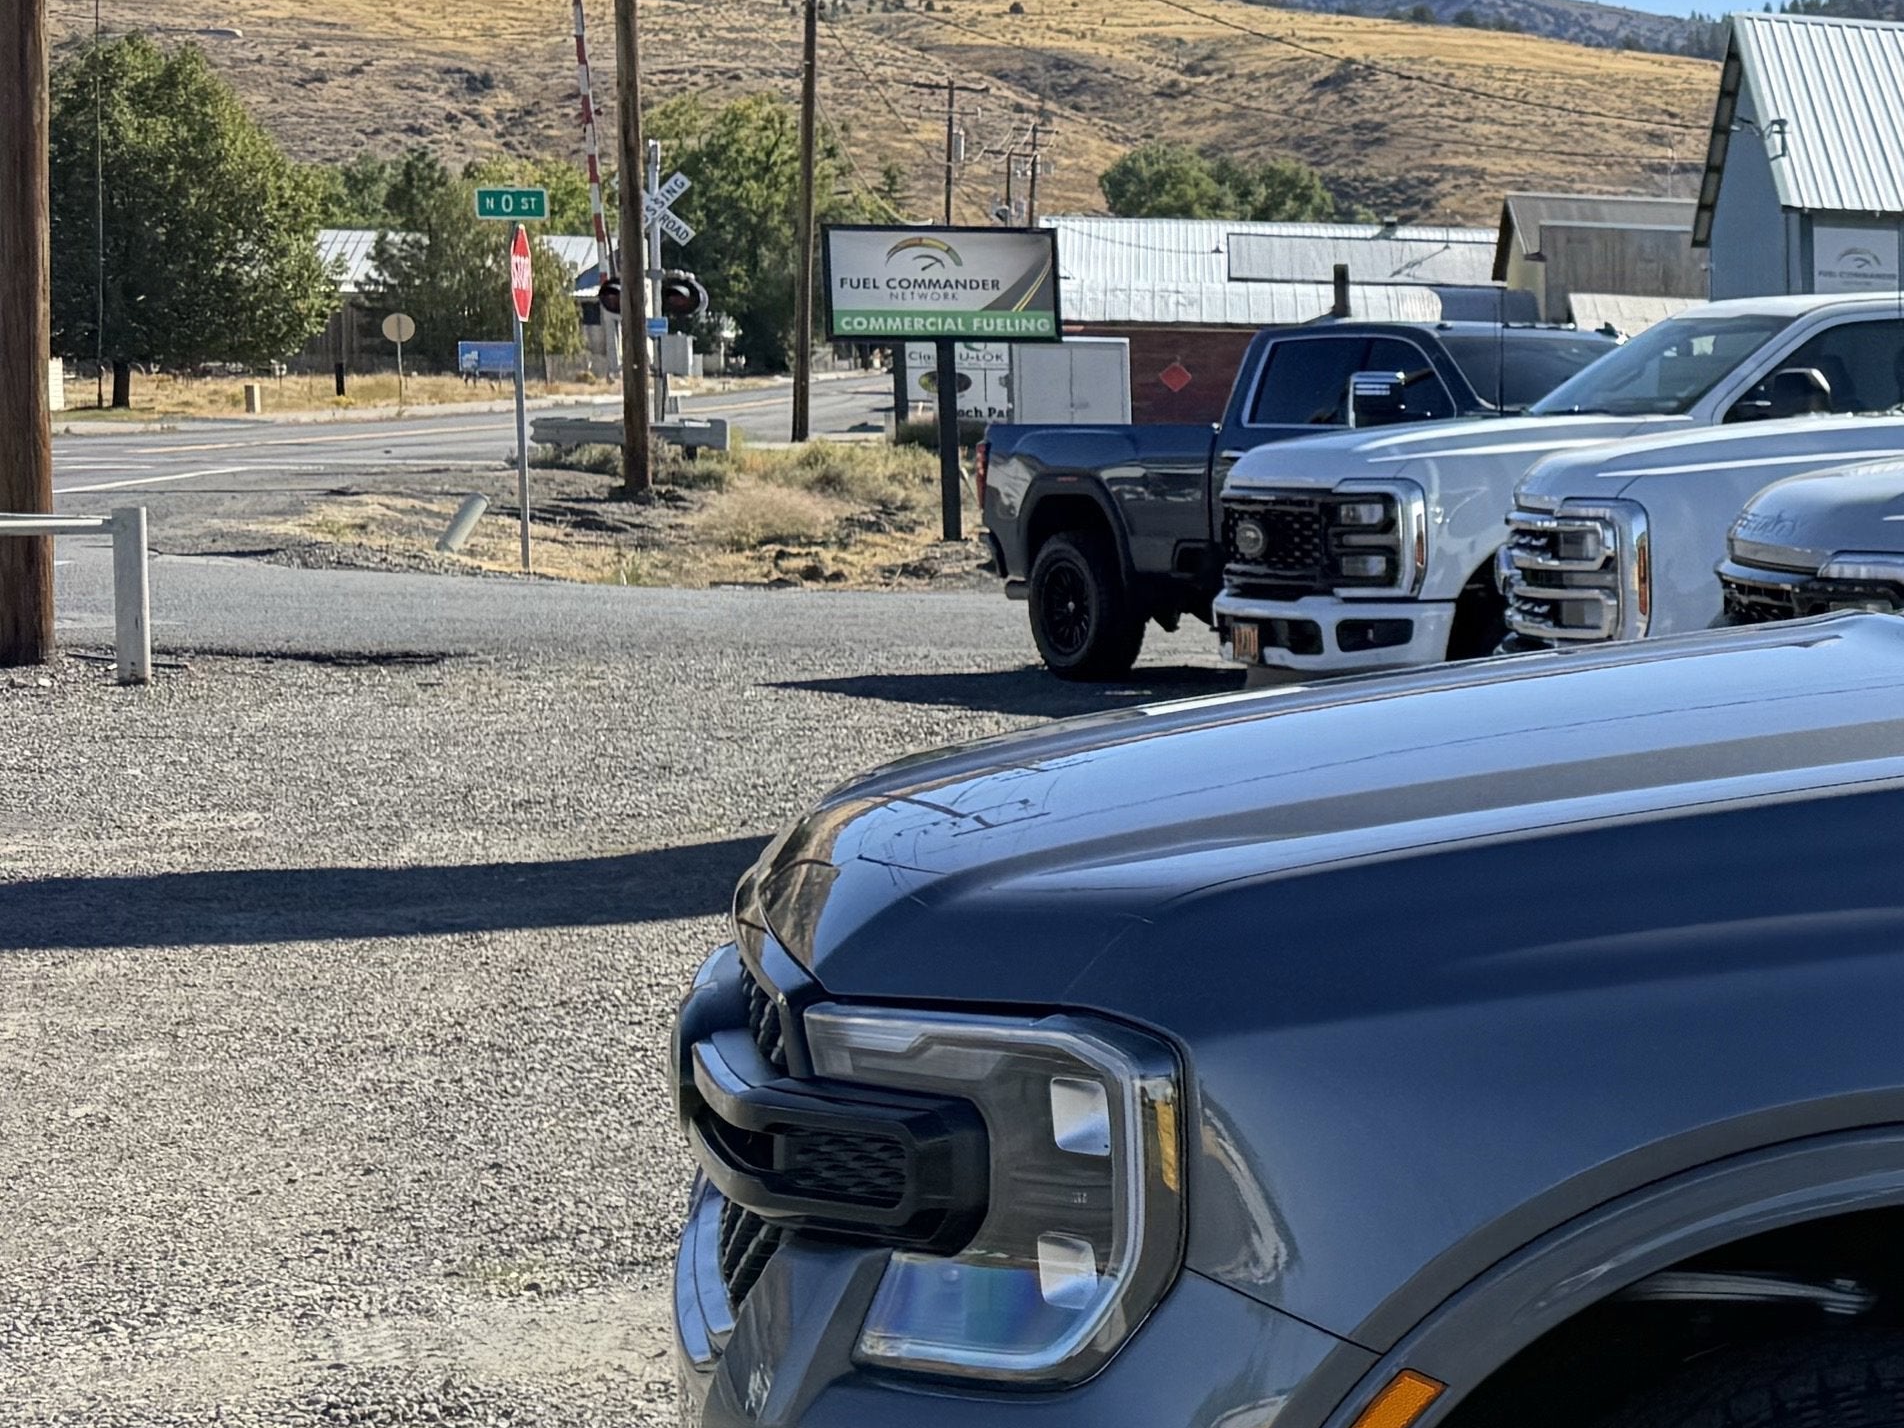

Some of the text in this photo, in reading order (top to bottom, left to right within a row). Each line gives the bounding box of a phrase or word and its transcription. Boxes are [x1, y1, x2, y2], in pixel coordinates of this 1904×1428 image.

[486, 197, 494, 210] N
[520, 197, 536, 210] ST
[659, 212, 689, 241] ROAD
[839, 277, 1000, 291] FUEL COMMANDER
[889, 291, 959, 301] NETWORK
[841, 316, 1051, 332] COMMERCIAL FUELING
